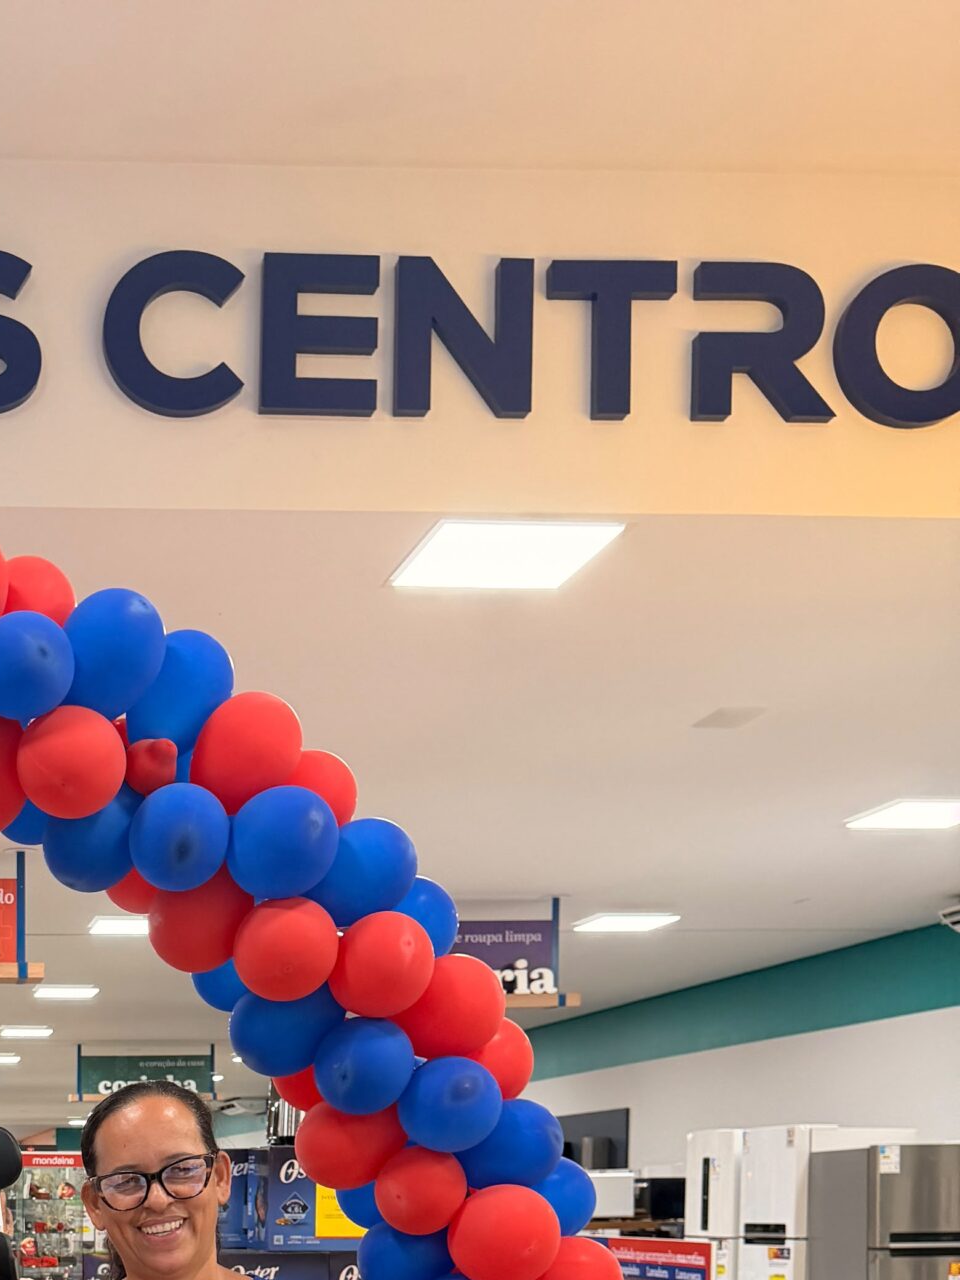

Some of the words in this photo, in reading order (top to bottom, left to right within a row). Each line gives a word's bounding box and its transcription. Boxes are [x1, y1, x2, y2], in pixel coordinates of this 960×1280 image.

[102, 249, 960, 429] CENTRO
[464, 933, 503, 946] roupa
[505, 930, 542, 946] limpa
[32, 1156, 75, 1165] mondaine
